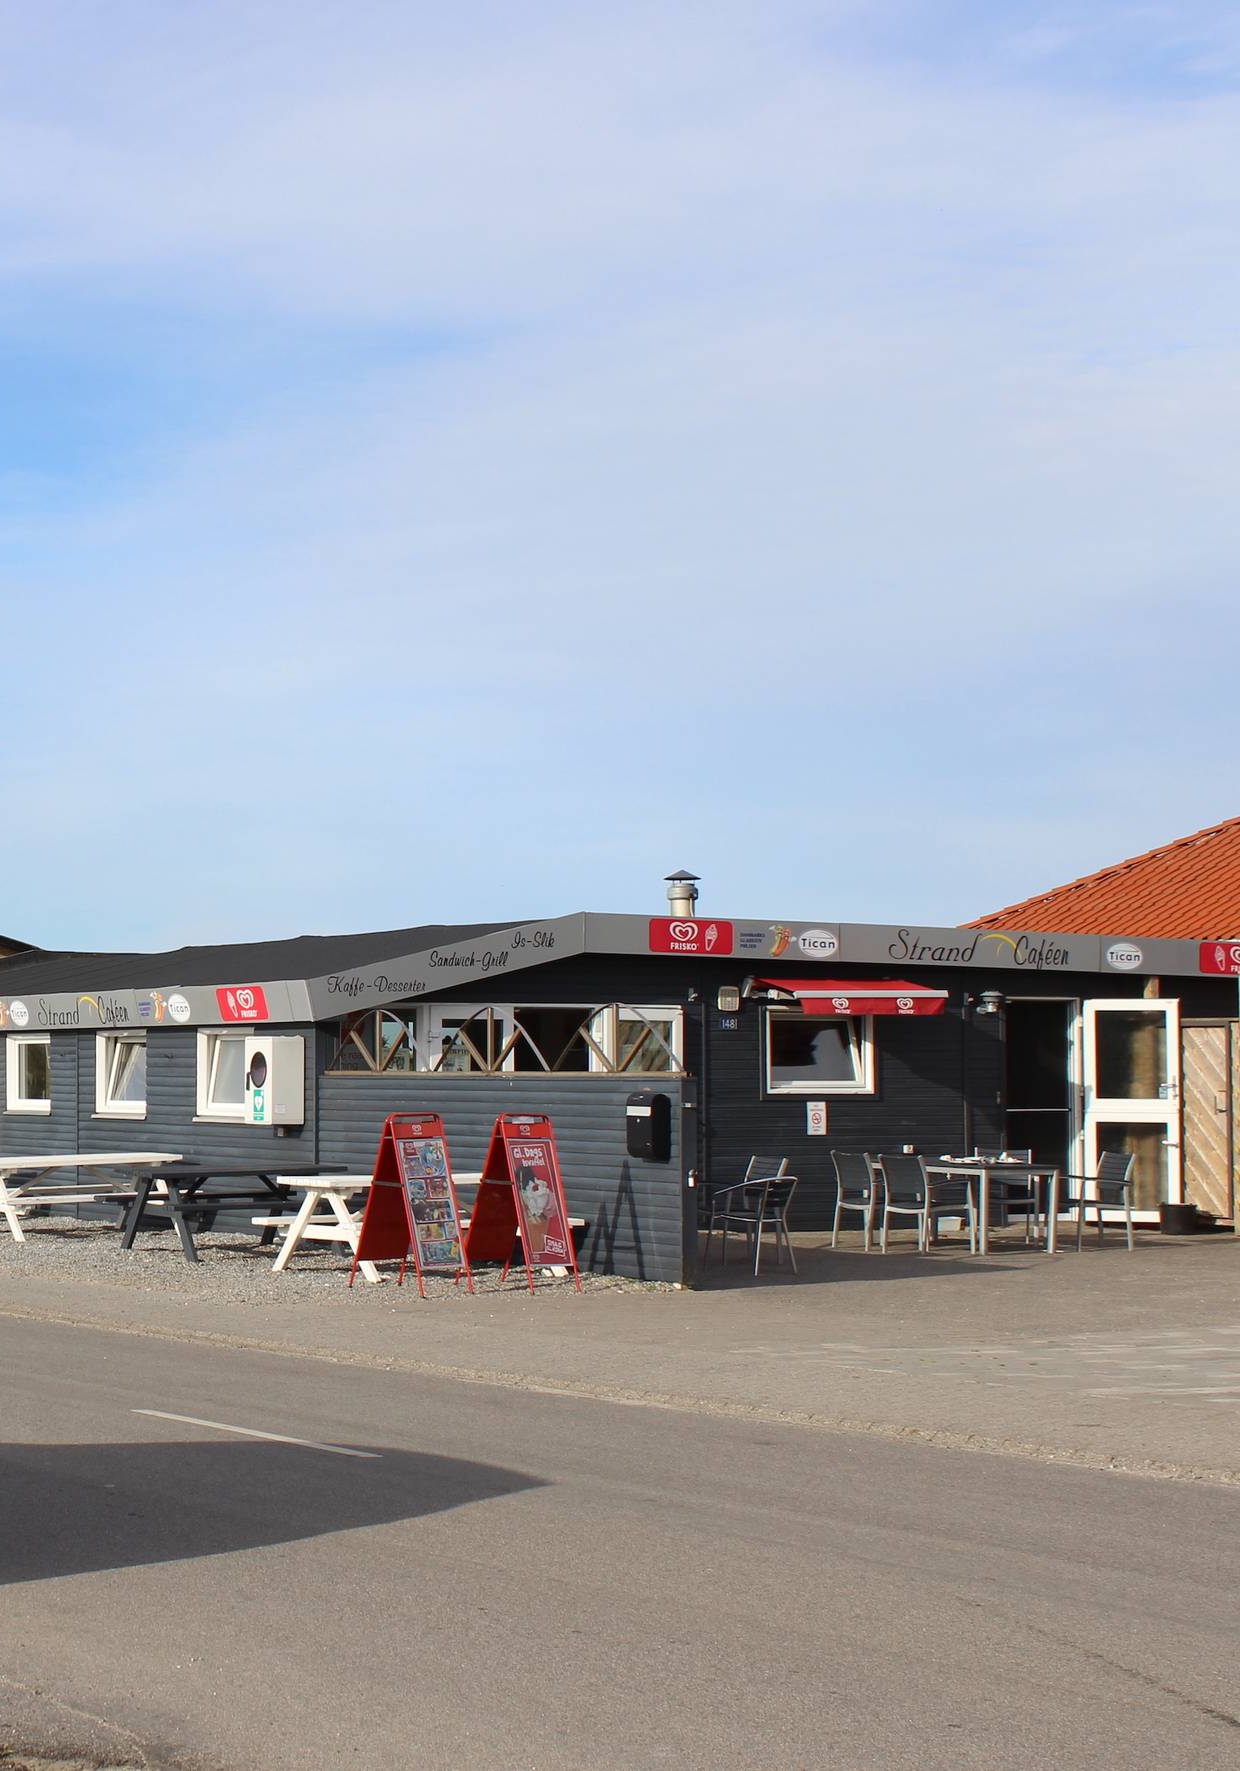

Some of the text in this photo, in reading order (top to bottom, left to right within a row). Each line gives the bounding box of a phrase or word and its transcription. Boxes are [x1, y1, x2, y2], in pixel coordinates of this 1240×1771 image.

[511, 931, 555, 949] Is-Slik
[670, 942, 698, 951] FRISKO
[801, 938, 835, 949] Tican
[888, 928, 1069, 970] Strand Caféen
[429, 950, 508, 971] Sandwich-Grill
[1109, 951, 1140, 961] Tican
[37, 998, 80, 1026] Strand
[98, 996, 130, 1027] Caféen
